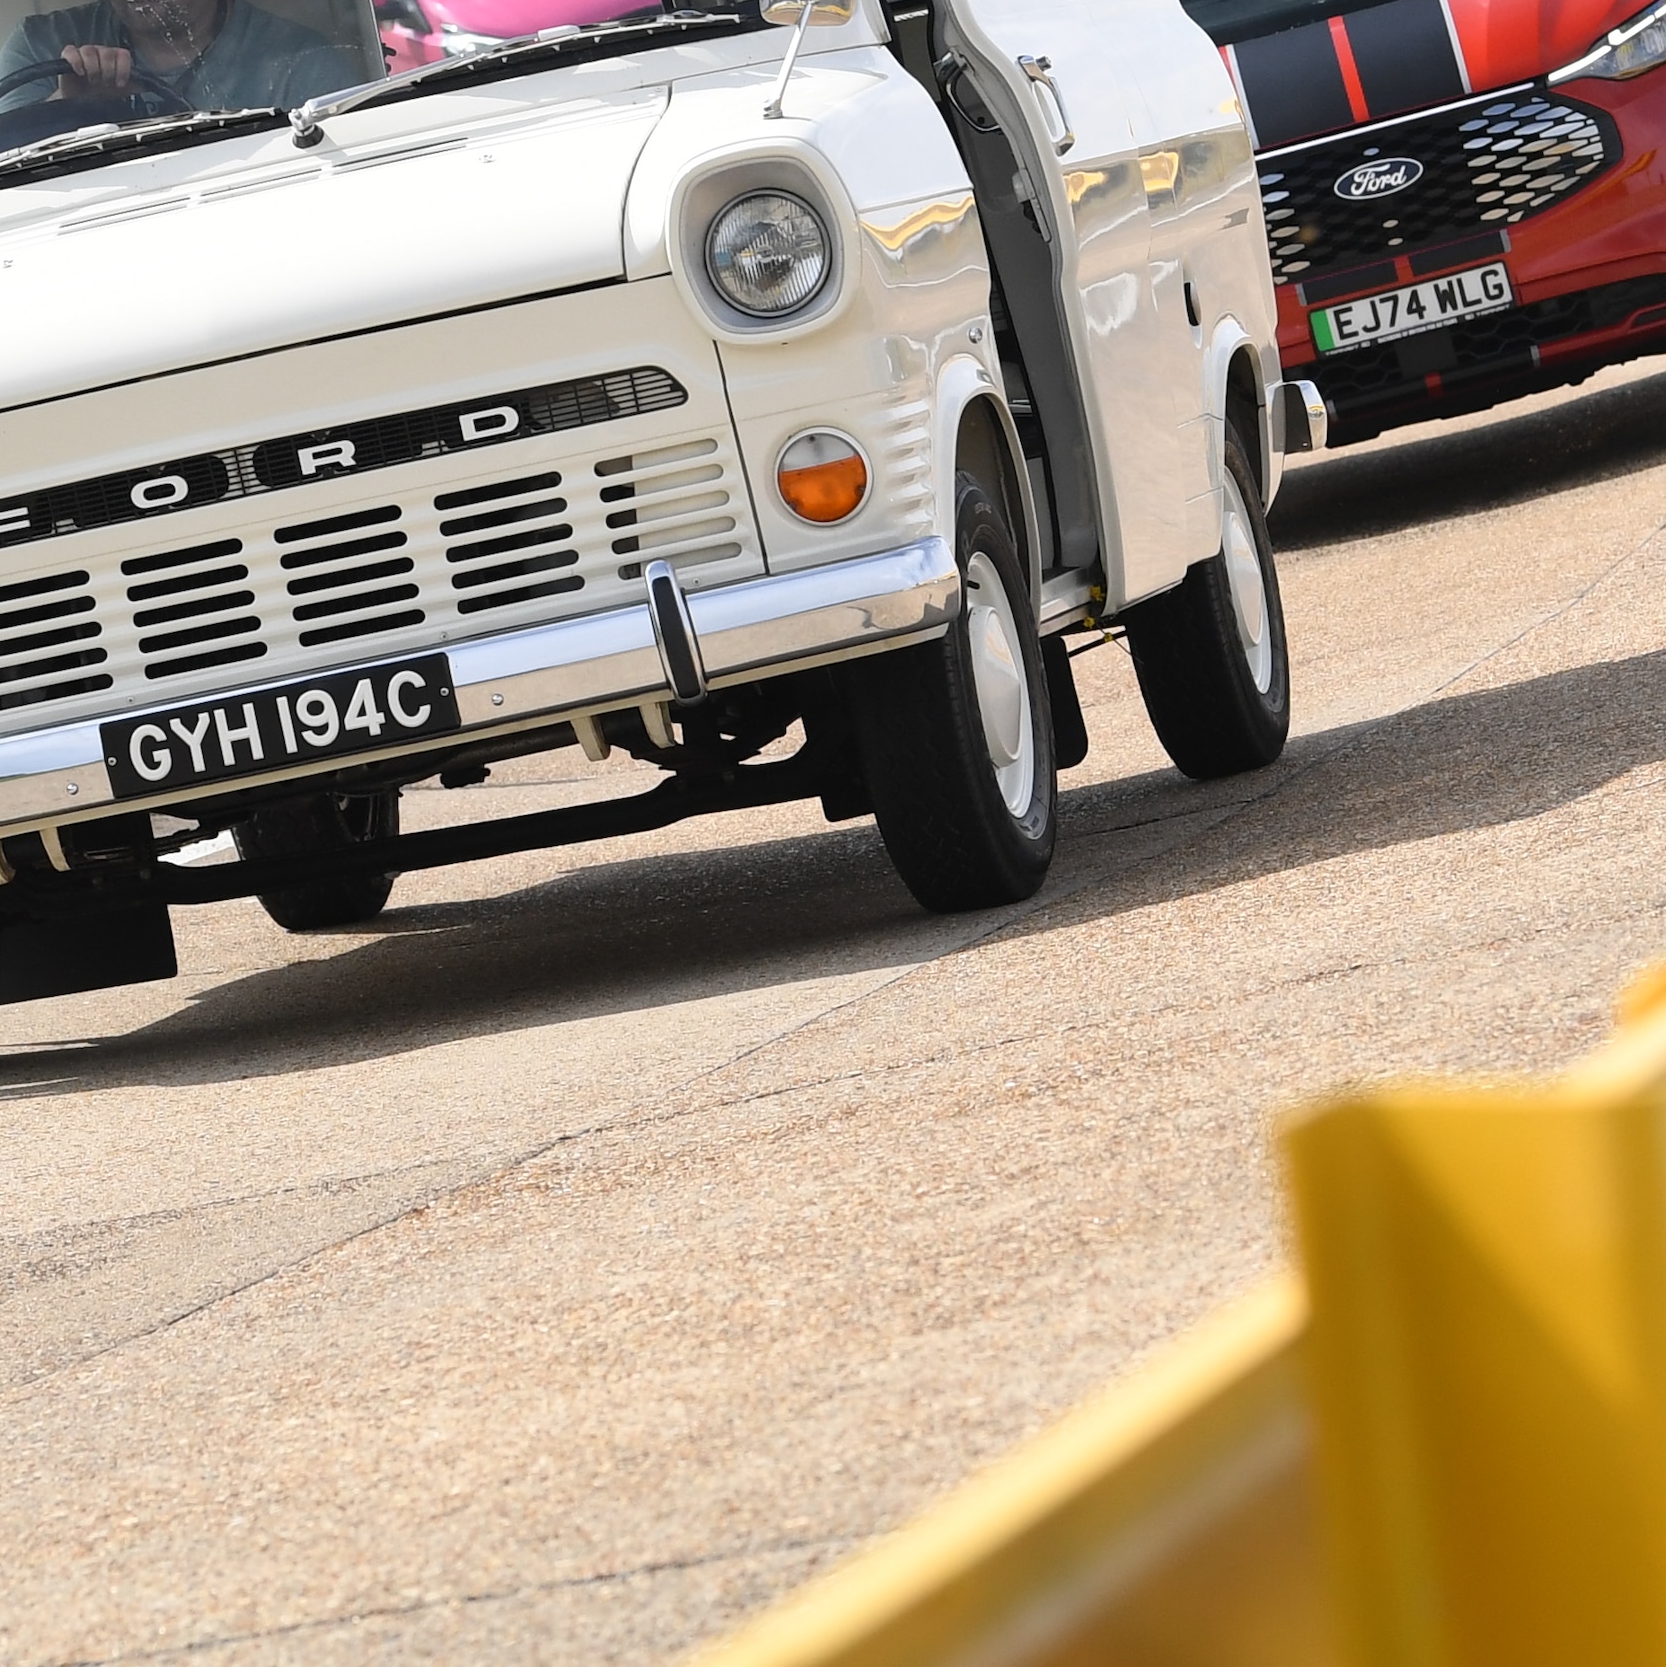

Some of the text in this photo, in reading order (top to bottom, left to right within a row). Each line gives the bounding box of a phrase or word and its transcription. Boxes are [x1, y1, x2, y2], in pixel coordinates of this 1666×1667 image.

[1350, 163, 1408, 195] Ford
[1334, 289, 1426, 340] EJ74
[1433, 269, 1505, 314] WLG
[129, 670, 432, 781] GYH 194C
